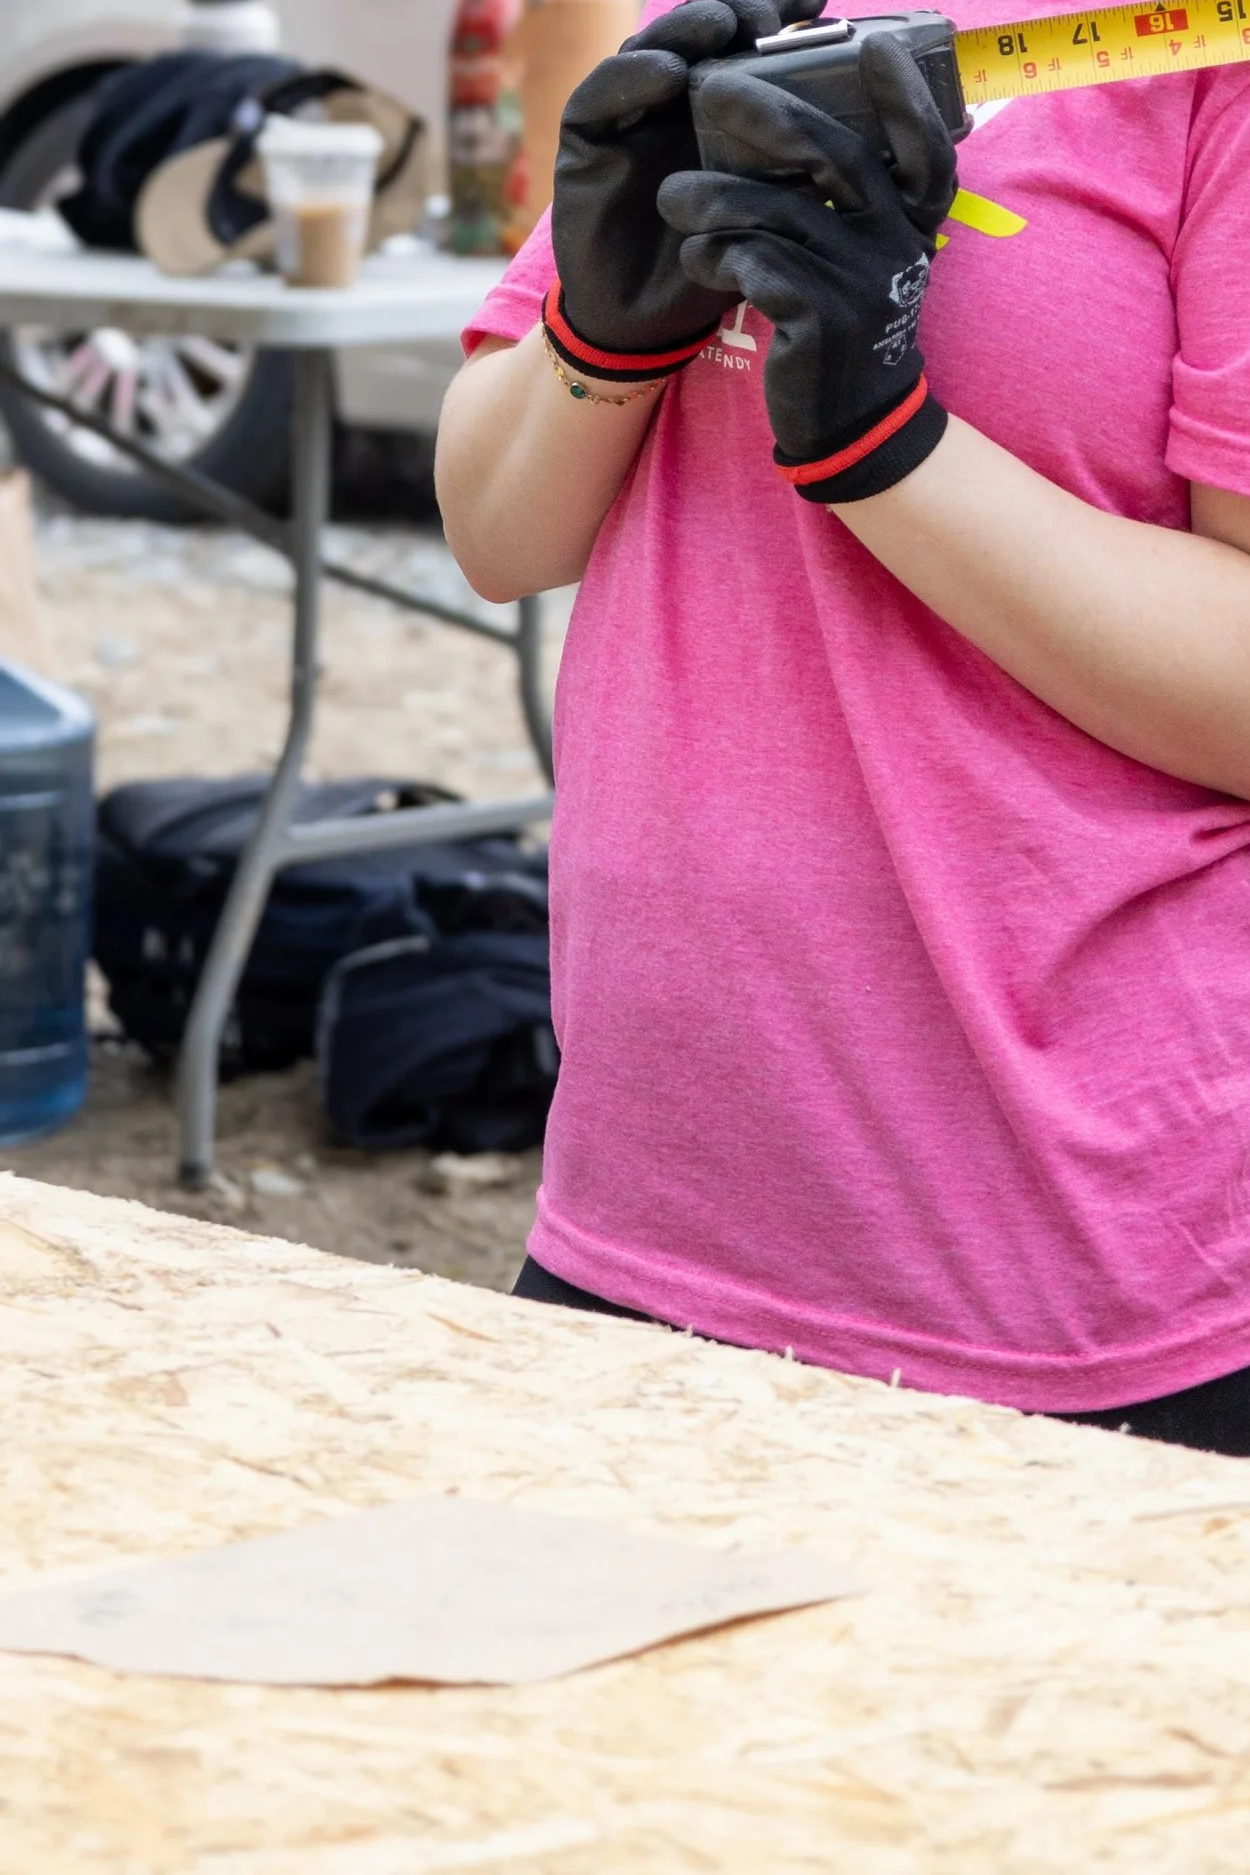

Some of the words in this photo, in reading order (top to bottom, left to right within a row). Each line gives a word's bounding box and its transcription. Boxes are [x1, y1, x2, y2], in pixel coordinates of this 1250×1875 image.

[1149, 14, 1174, 32] 16
[1071, 21, 1101, 45] 17
[997, 32, 1028, 56] 18
[1168, 39, 1182, 56] 4
[1096, 50, 1111, 68] 5
[1023, 62, 1037, 79] 6
